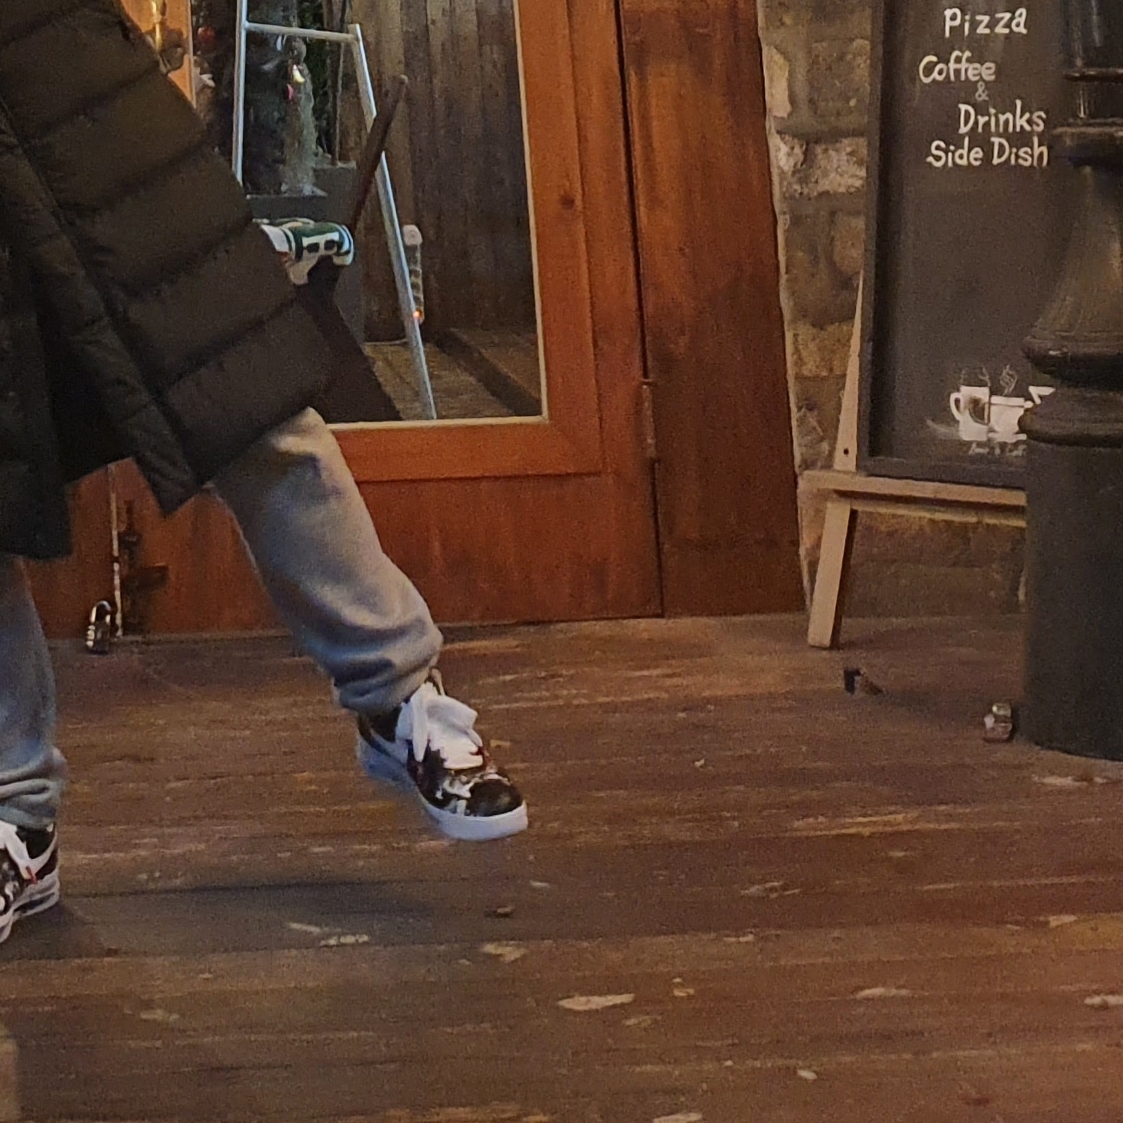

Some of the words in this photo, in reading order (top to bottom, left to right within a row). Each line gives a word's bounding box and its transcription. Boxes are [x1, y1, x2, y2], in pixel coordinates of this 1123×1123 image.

[944, 7, 1027, 38] Pizza
[919, 50, 996, 83] Coffee
[975, 81, 989, 101] &
[958, 99, 1046, 134] Drinks
[926, 136, 983, 167] Side
[990, 135, 1048, 167] Dish
